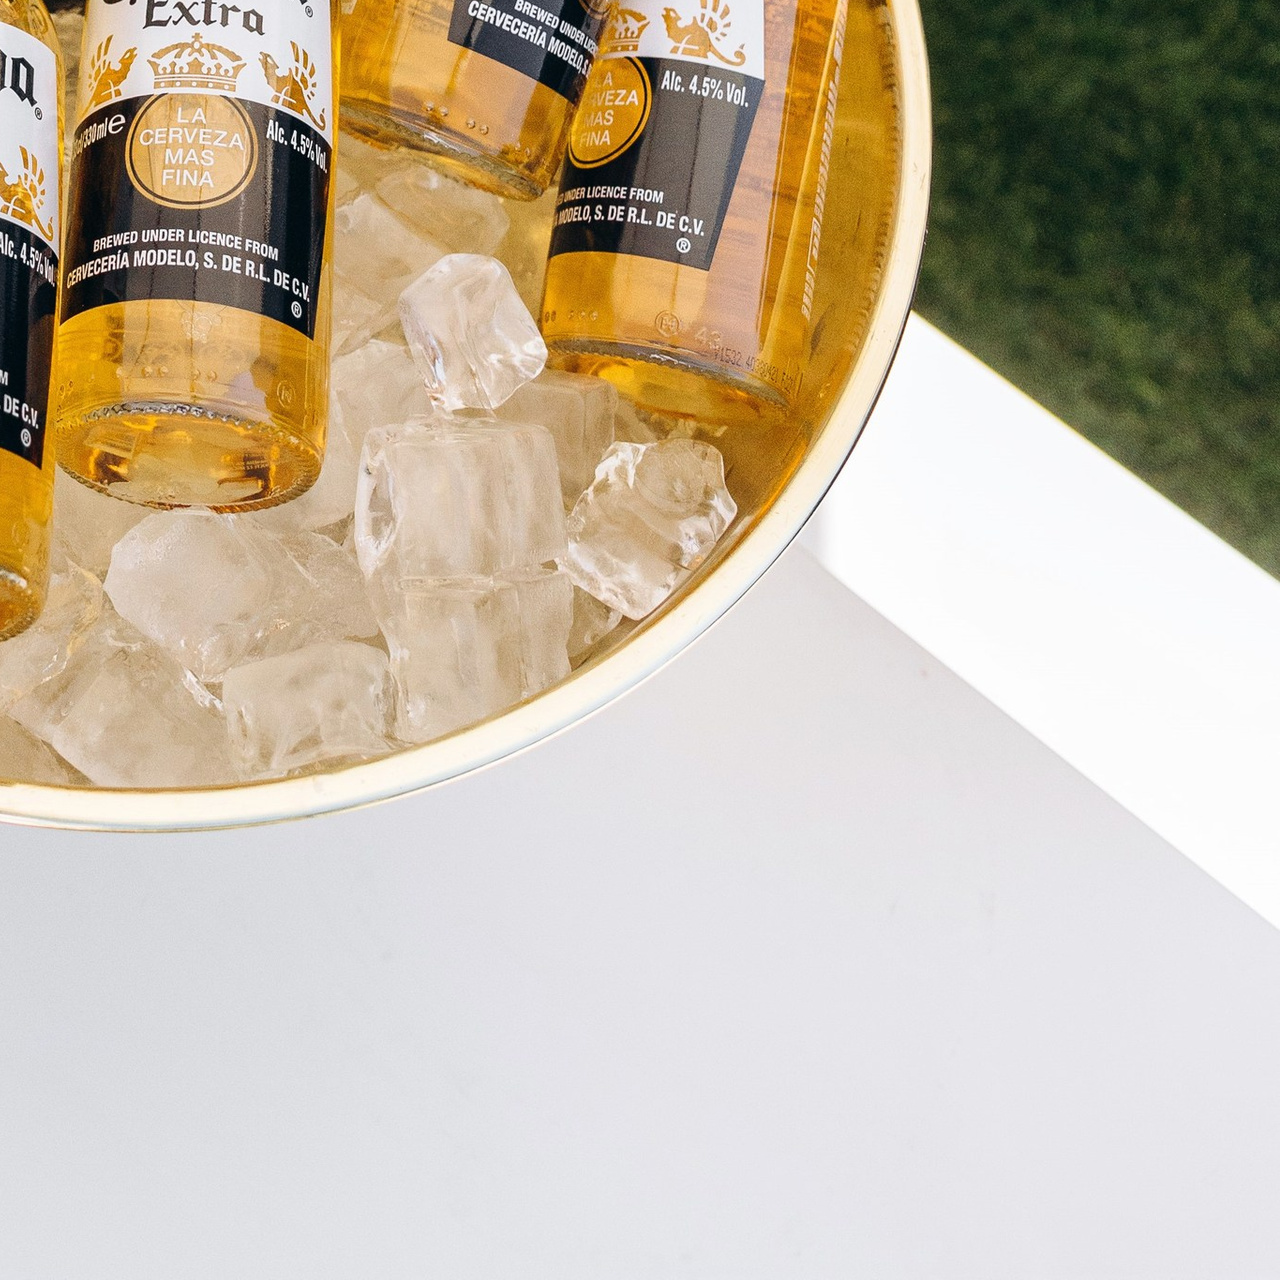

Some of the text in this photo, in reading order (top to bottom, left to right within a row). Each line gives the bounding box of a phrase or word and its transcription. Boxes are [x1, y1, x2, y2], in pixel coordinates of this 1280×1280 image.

[468, 0, 547, 49] CERVECERÍA
[560, 20, 585, 45] UNDER
[590, 90, 639, 107] VEZA
[661, 70, 749, 108] Alc. 4.5% Vol.
[177, 107, 206, 124] LA
[139, 127, 245, 151] CERVEZA
[266, 120, 328, 174] Alc. 4.5% Vol.
[165, 149, 215, 167] MAS
[162, 169, 215, 188] FINA
[587, 186, 627, 199] LICENCE
[629, 187, 664, 204] FROM
[594, 204, 605, 220] S.
[607, 204, 625, 222] DE
[627, 207, 652, 225] R.L.
[656, 211, 675, 229] DE
[679, 215, 705, 236] C.V.
[20, 241, 44, 274] 4.5%
[93, 229, 279, 262] BREWED UNDER LICENCE FROM
[66, 249, 310, 303] CERVECERÍA MODELO, S. DE R.L. DE C.V.
[3, 394, 20, 417] DE
[21, 400, 39, 430] C.V.
